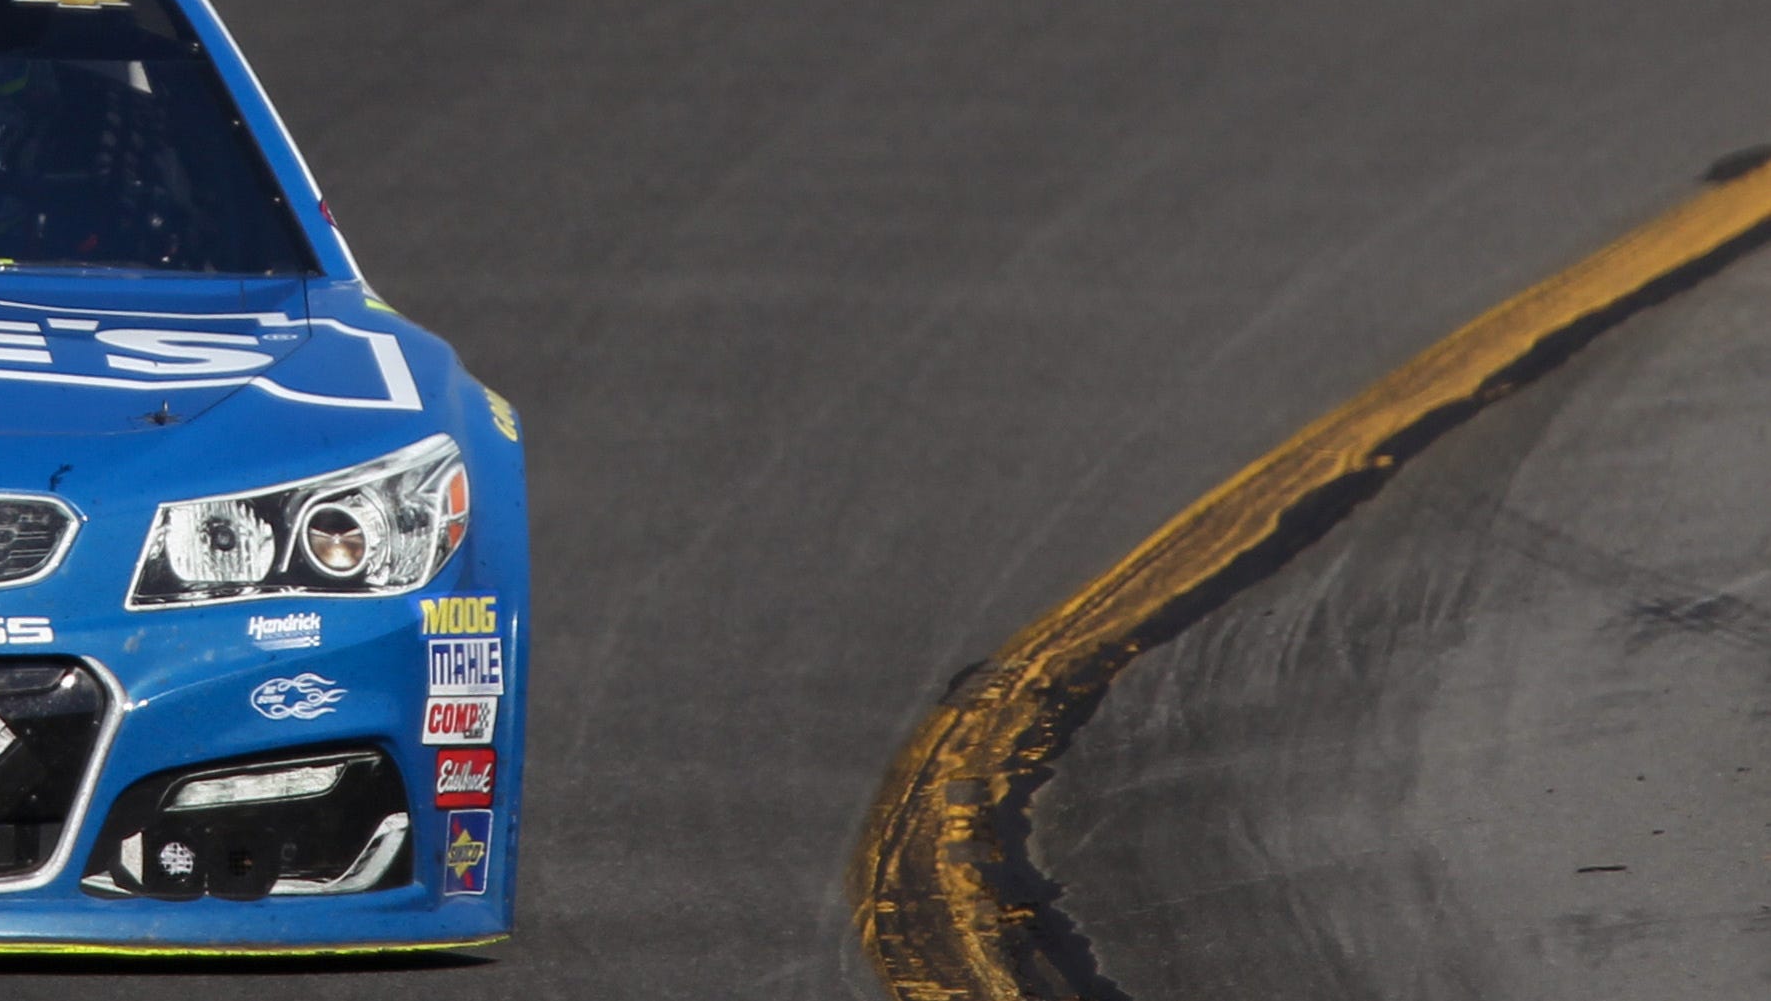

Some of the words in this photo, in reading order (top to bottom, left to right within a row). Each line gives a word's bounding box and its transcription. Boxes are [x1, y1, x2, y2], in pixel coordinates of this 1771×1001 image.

[248, 612, 322, 640] Hendrick
[420, 596, 497, 635] MOOG
[432, 642, 500, 685] MAHLE
[428, 703, 479, 734] COMP
